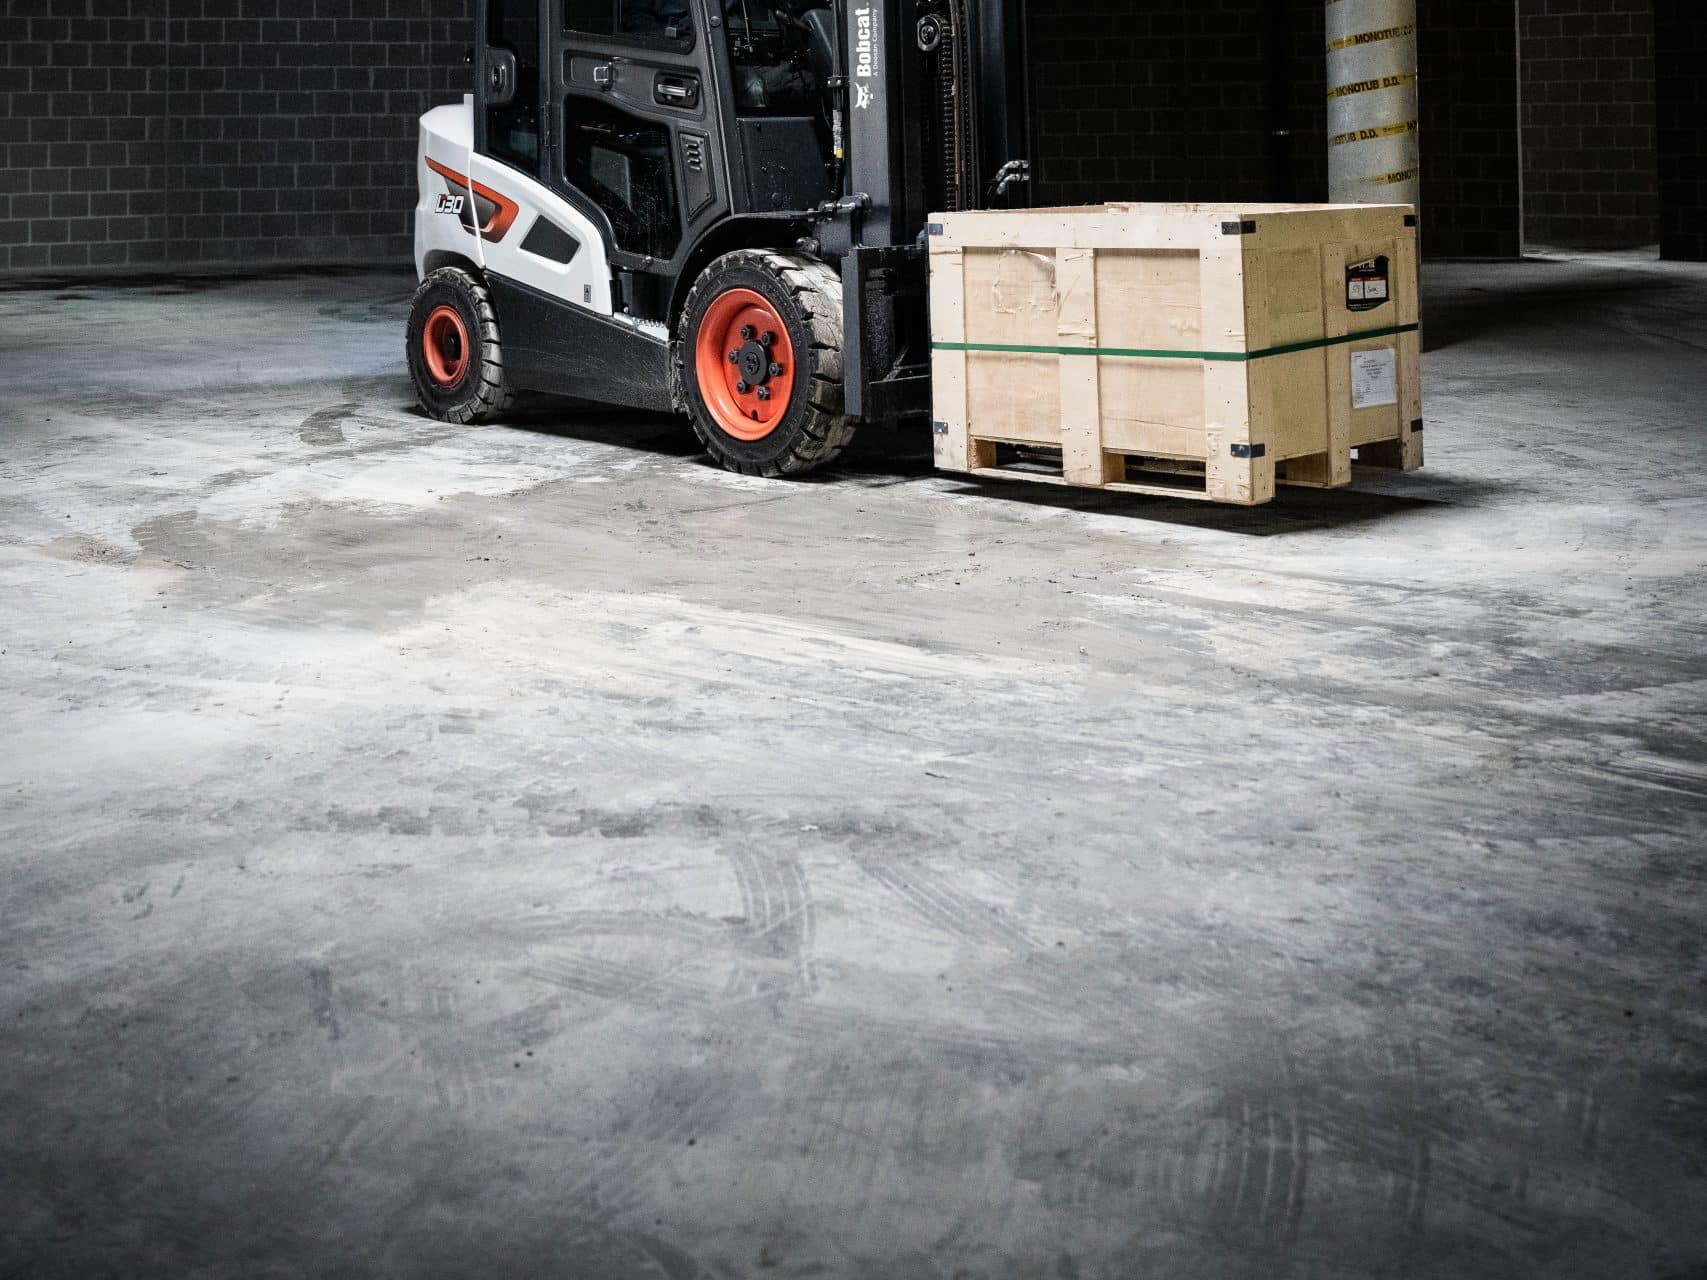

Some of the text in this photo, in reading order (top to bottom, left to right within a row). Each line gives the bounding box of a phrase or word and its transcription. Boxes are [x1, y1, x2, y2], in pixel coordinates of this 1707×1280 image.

[855, 7, 872, 77] Bobcat
[1335, 80, 1380, 97] MONOTUB
[1360, 129, 1378, 140] D.D.
